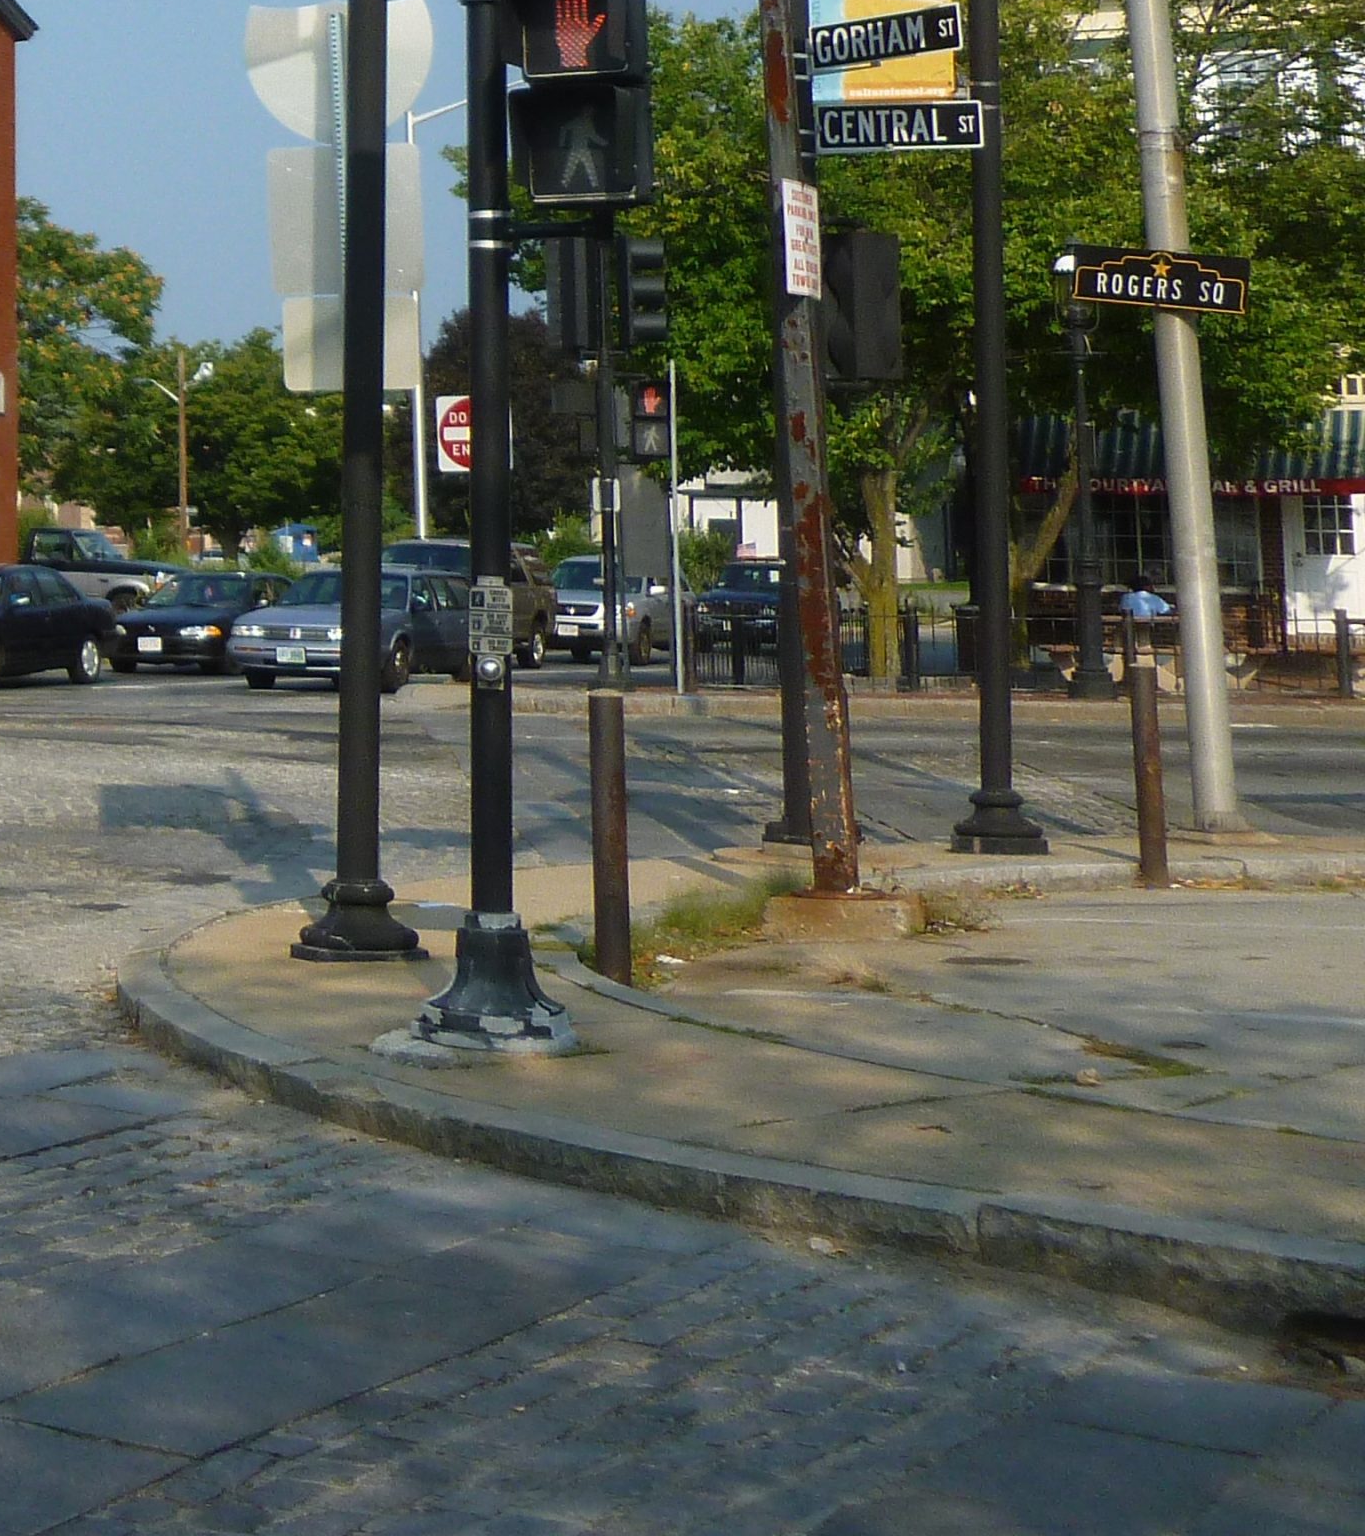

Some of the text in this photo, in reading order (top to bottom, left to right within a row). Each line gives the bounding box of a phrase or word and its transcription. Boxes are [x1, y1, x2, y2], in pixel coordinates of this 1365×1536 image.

[815, 15, 955, 64] GORHAM ST
[823, 108, 976, 145] CENTRAL ST
[1096, 272, 1225, 305] ROGERS SQ
[449, 411, 467, 424] DO
[1244, 479, 1258, 494] &
[1263, 478, 1322, 494] GRILL
